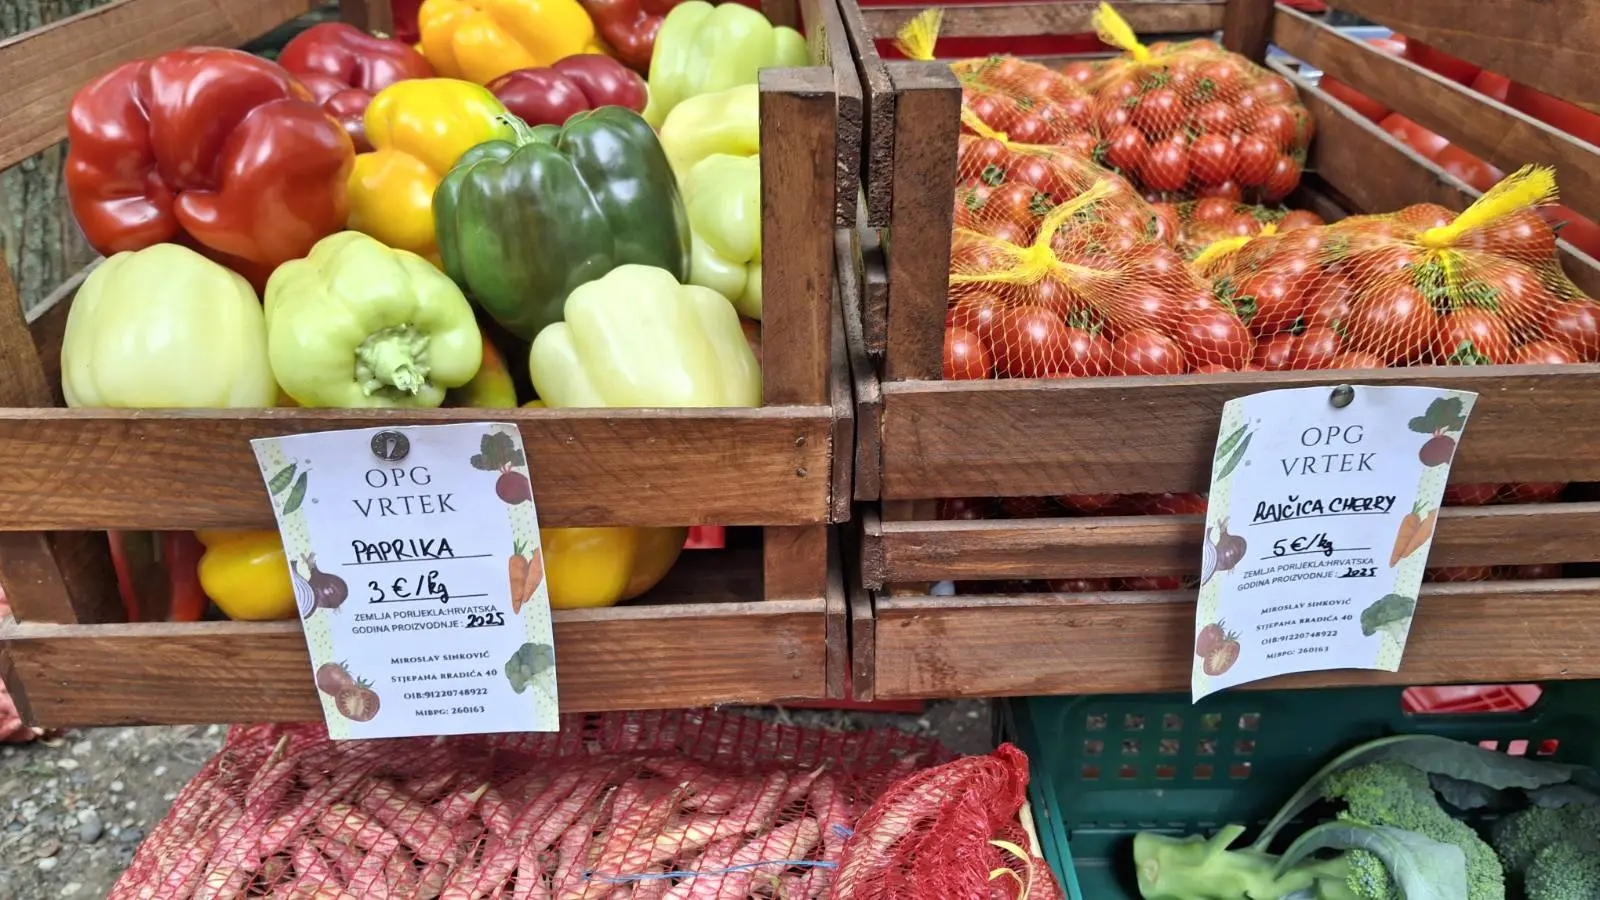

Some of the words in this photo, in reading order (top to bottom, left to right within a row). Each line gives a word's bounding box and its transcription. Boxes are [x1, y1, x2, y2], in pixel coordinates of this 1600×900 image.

[1301, 424, 1364, 446] OPG
[1280, 452, 1377, 477] VRTEK
[365, 466, 431, 488] OPG
[352, 493, 457, 518] VRTEK
[1253, 495, 1324, 521] RAJČICA
[1328, 495, 1396, 513] CHERRY
[352, 538, 454, 563] PAPRIKA
[1237, 580, 1270, 591] GODINA
[1340, 567, 1378, 577] 2025
[1243, 568, 1275, 579] ZEMLJA
[354, 612, 391, 622] ZEMLJA
[1260, 603, 1305, 615] MIROSLAV
[352, 624, 391, 634] GODINA
[466, 612, 505, 628] 2025
[1256, 620, 1296, 631] STJEPANA
[390, 655, 440, 664] MIROSLAV
[391, 674, 437, 683] STJEPANA
[485, 669, 497, 677] 40
[451, 705, 485, 714] 260163
